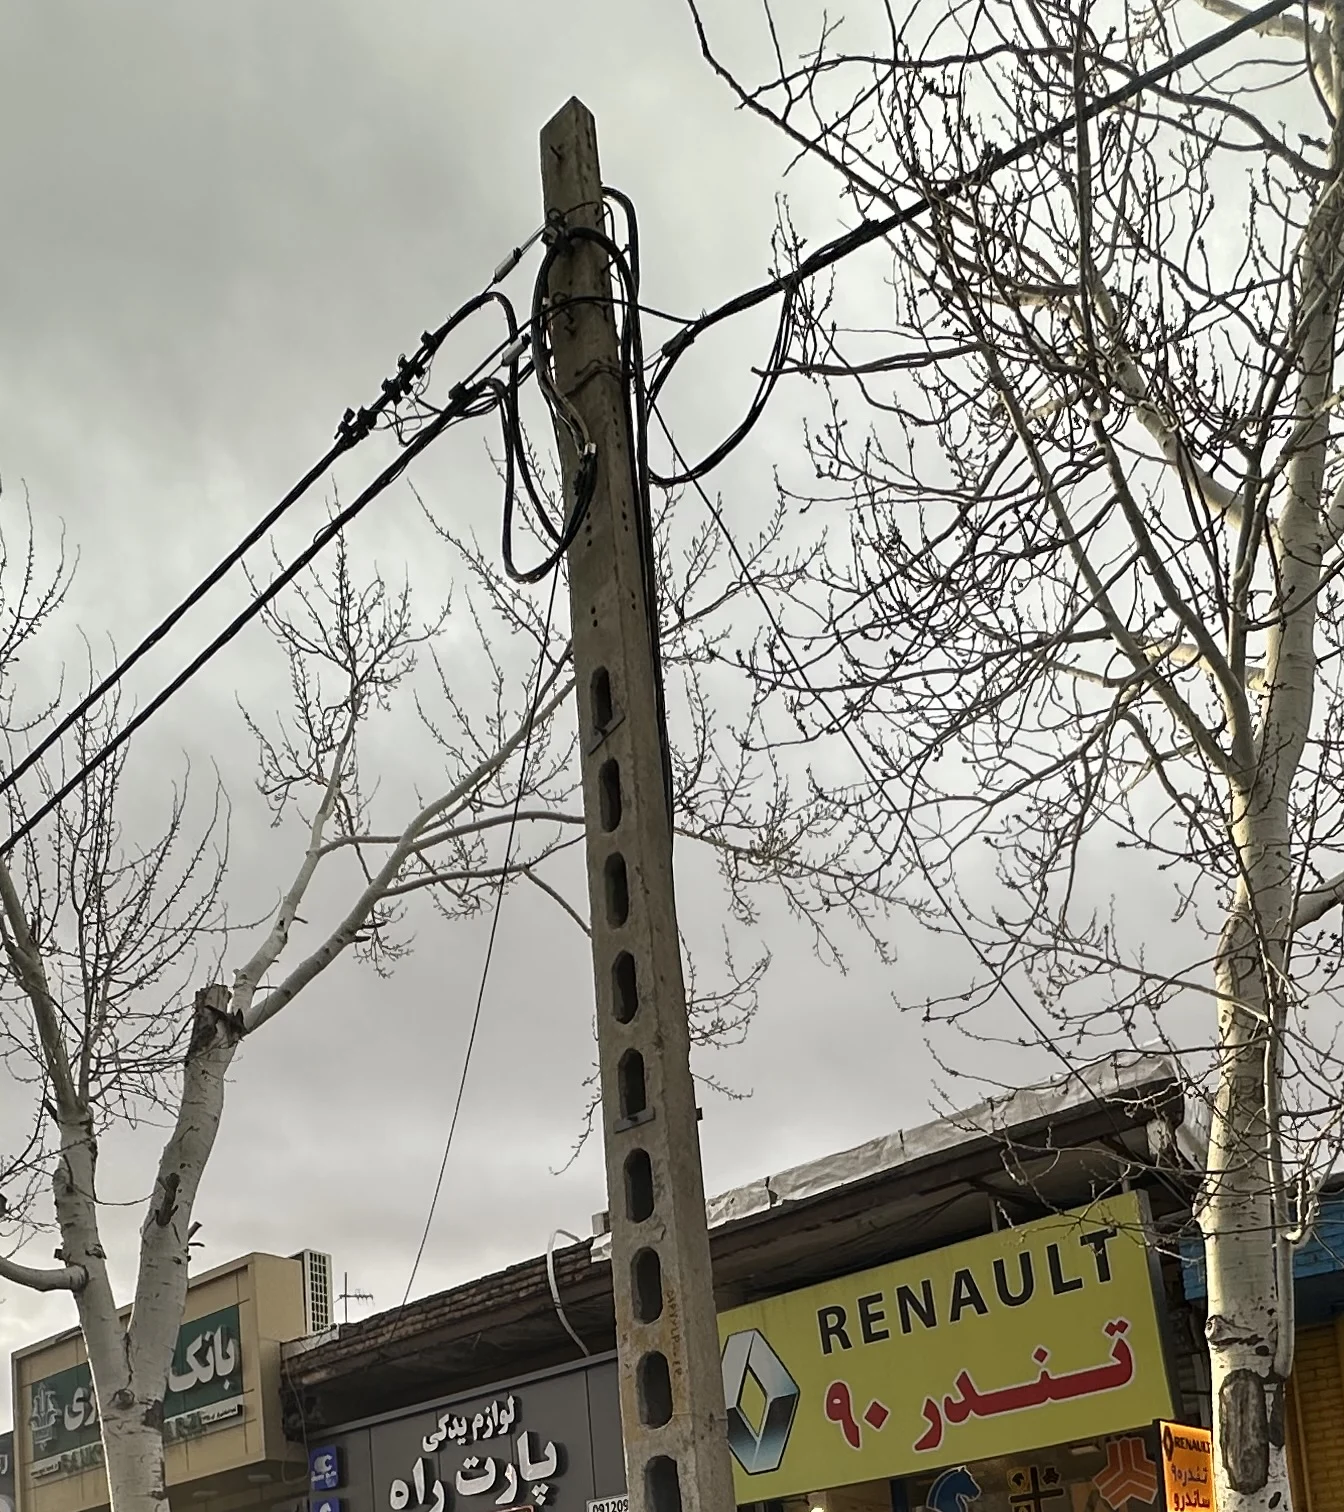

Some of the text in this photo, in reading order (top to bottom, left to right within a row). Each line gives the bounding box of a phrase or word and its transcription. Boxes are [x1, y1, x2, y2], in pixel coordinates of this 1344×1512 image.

[815, 1226, 1119, 1356] RENAULT
[168, 1325, 237, 1394] بانک
[823, 1315, 1136, 1453] تندر ۹۰
[422, 1395, 516, 1453] لوازم یدکی
[1174, 1436, 1211, 1454] RENAULT
[456, 1430, 558, 1506] پارت
